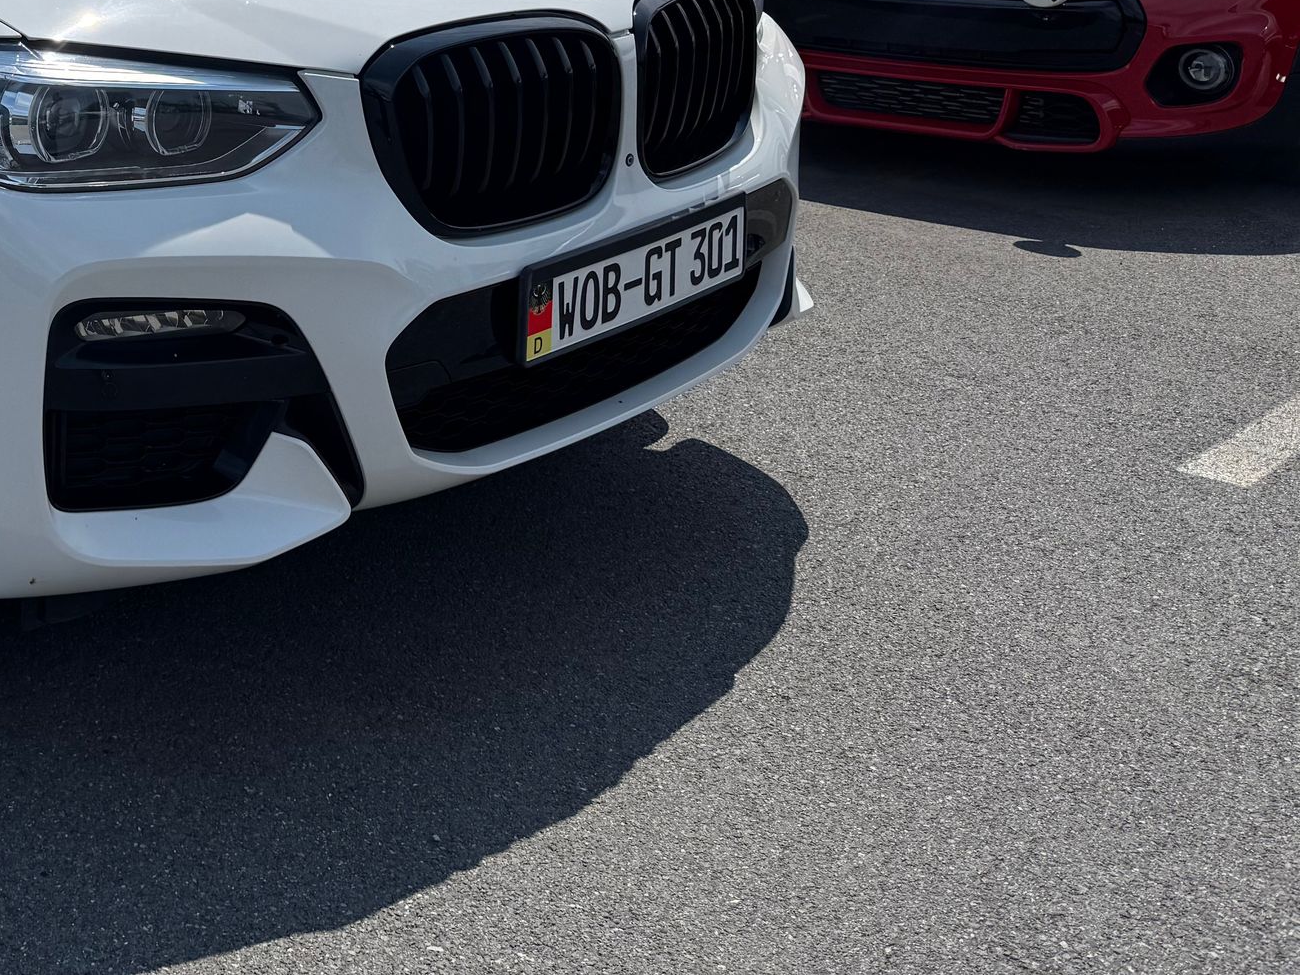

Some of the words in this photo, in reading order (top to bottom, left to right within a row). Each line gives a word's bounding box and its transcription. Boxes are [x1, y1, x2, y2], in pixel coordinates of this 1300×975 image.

[557, 237, 682, 341] WOB-GT
[689, 214, 740, 287] 301
[533, 336, 543, 355] D
